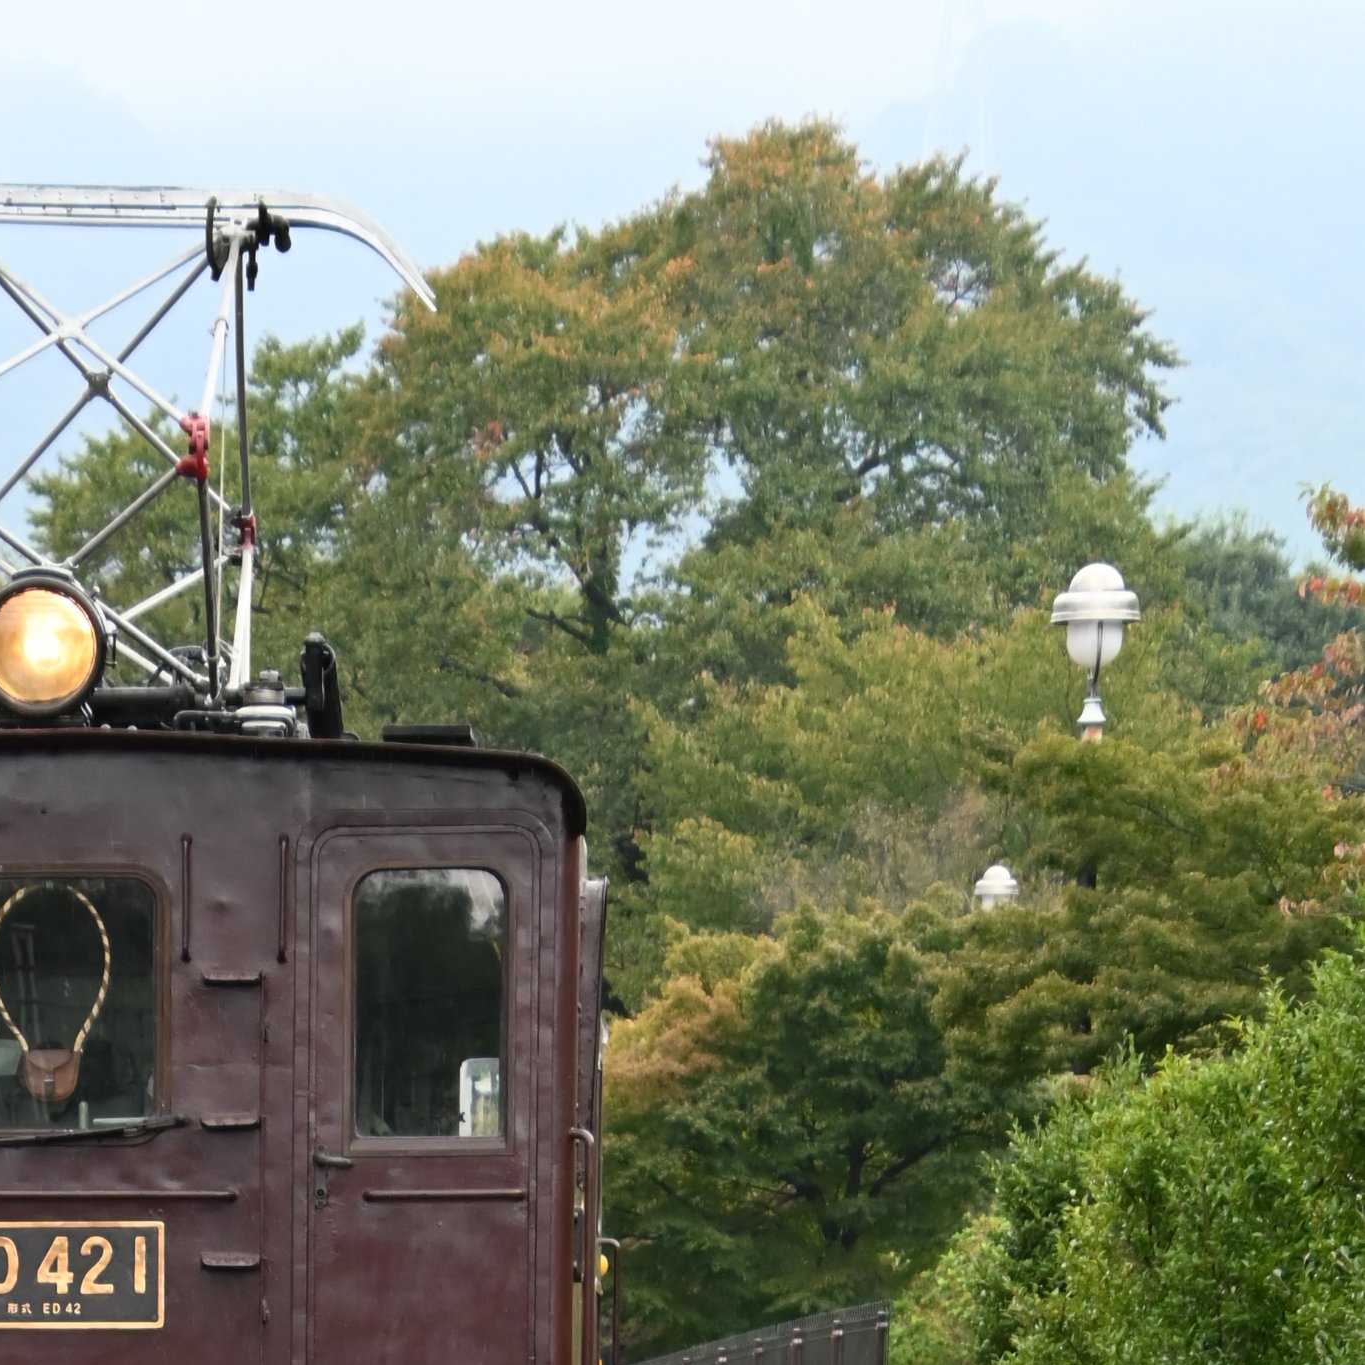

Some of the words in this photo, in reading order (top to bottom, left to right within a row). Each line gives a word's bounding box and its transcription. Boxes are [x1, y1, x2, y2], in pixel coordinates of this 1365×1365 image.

[7, 1302, 32, 1314] 形式
[43, 1302, 61, 1314] ED
[65, 1302, 81, 1314] 42
